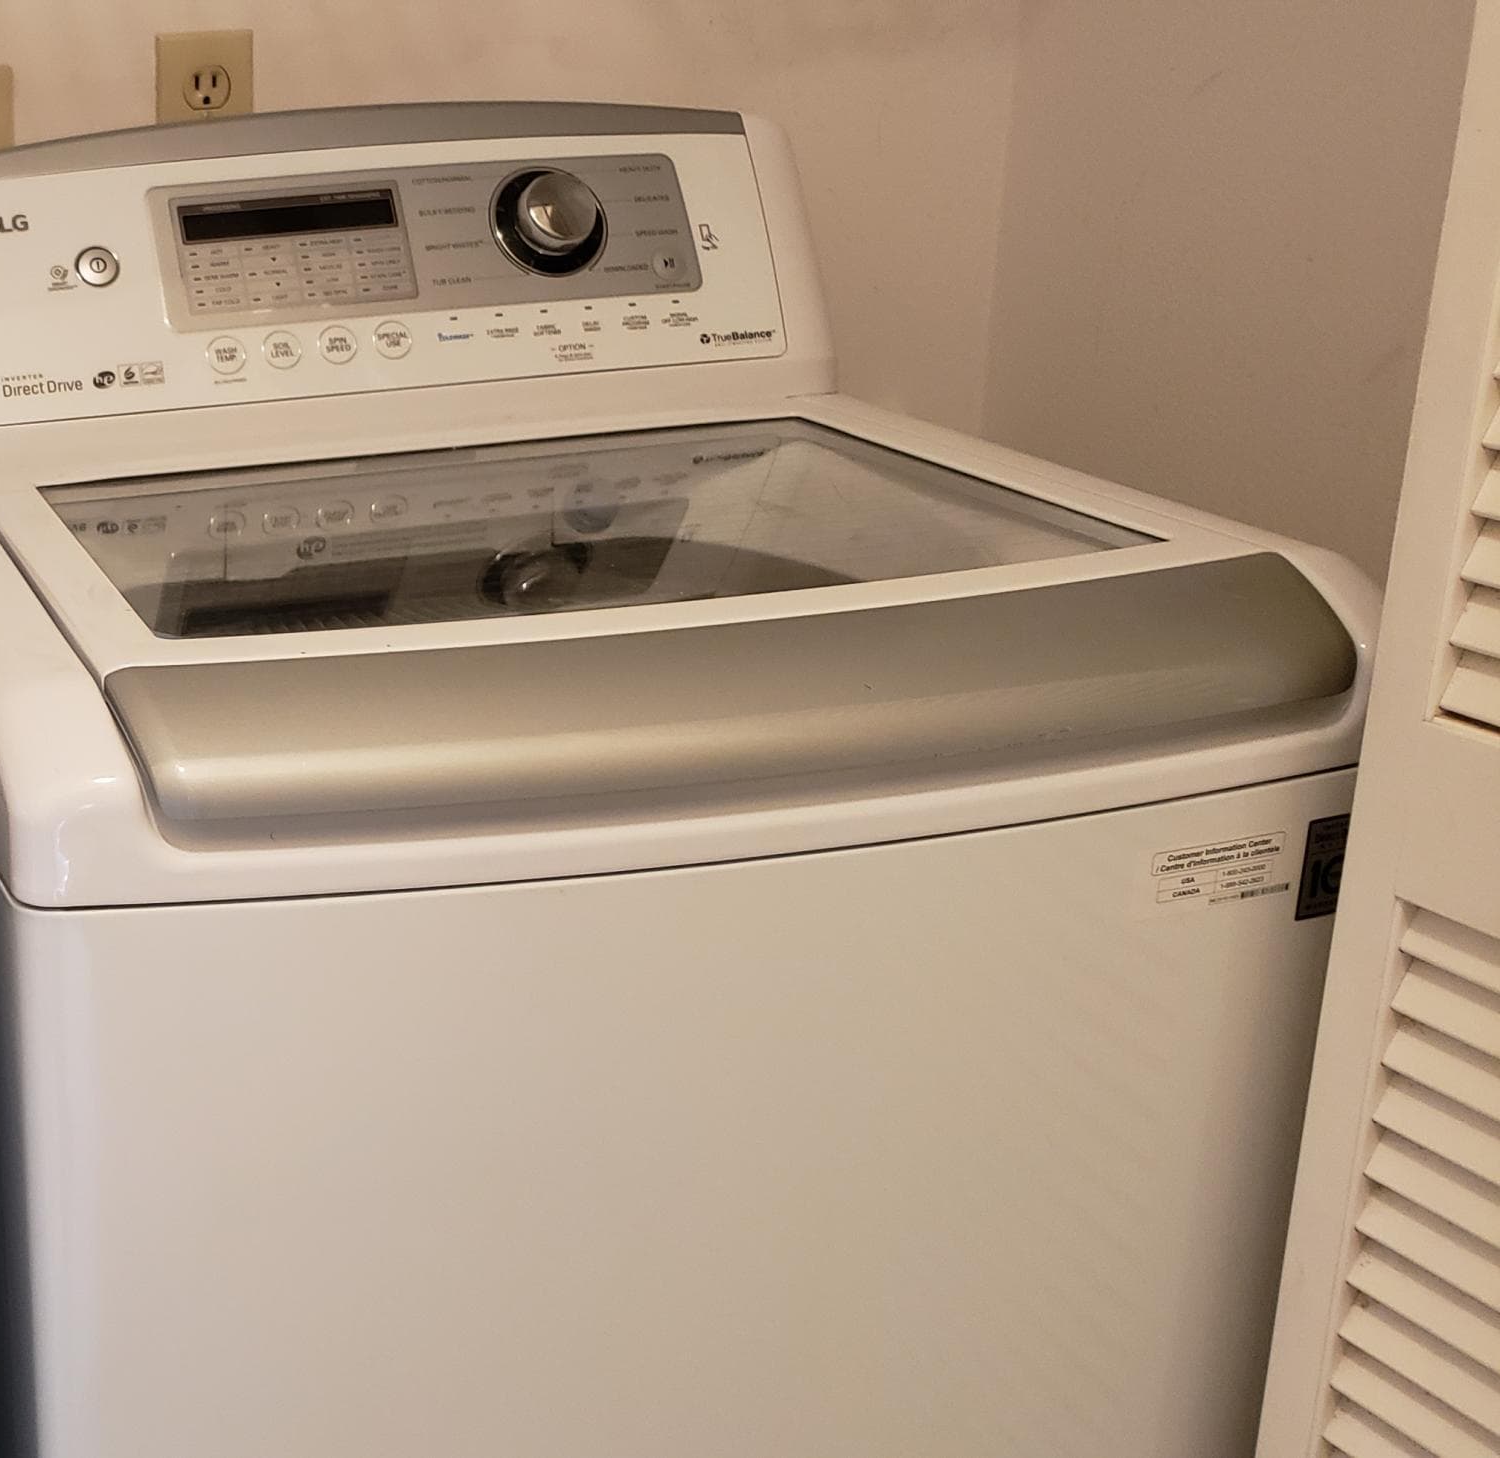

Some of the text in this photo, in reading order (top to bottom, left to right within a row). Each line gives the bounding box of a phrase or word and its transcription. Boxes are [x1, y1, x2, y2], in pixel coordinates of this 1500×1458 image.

[378, 331, 408, 341] SPECIAL
[328, 337, 347, 346] SPIN
[385, 340, 401, 348] USE
[214, 346, 237, 356] WASH
[326, 345, 352, 354] SPEED
[558, 343, 586, 353] OPTION
[271, 350, 295, 359] LEVEL
[1, 373, 44, 383] INVERTER
[2, 378, 83, 398] Direct Drive
[1167, 838, 1273, 863] Customer Information Center
[1160, 863, 1185, 873] Centre
[1181, 876, 1196, 885] USA
[1172, 887, 1201, 899] CANADA
